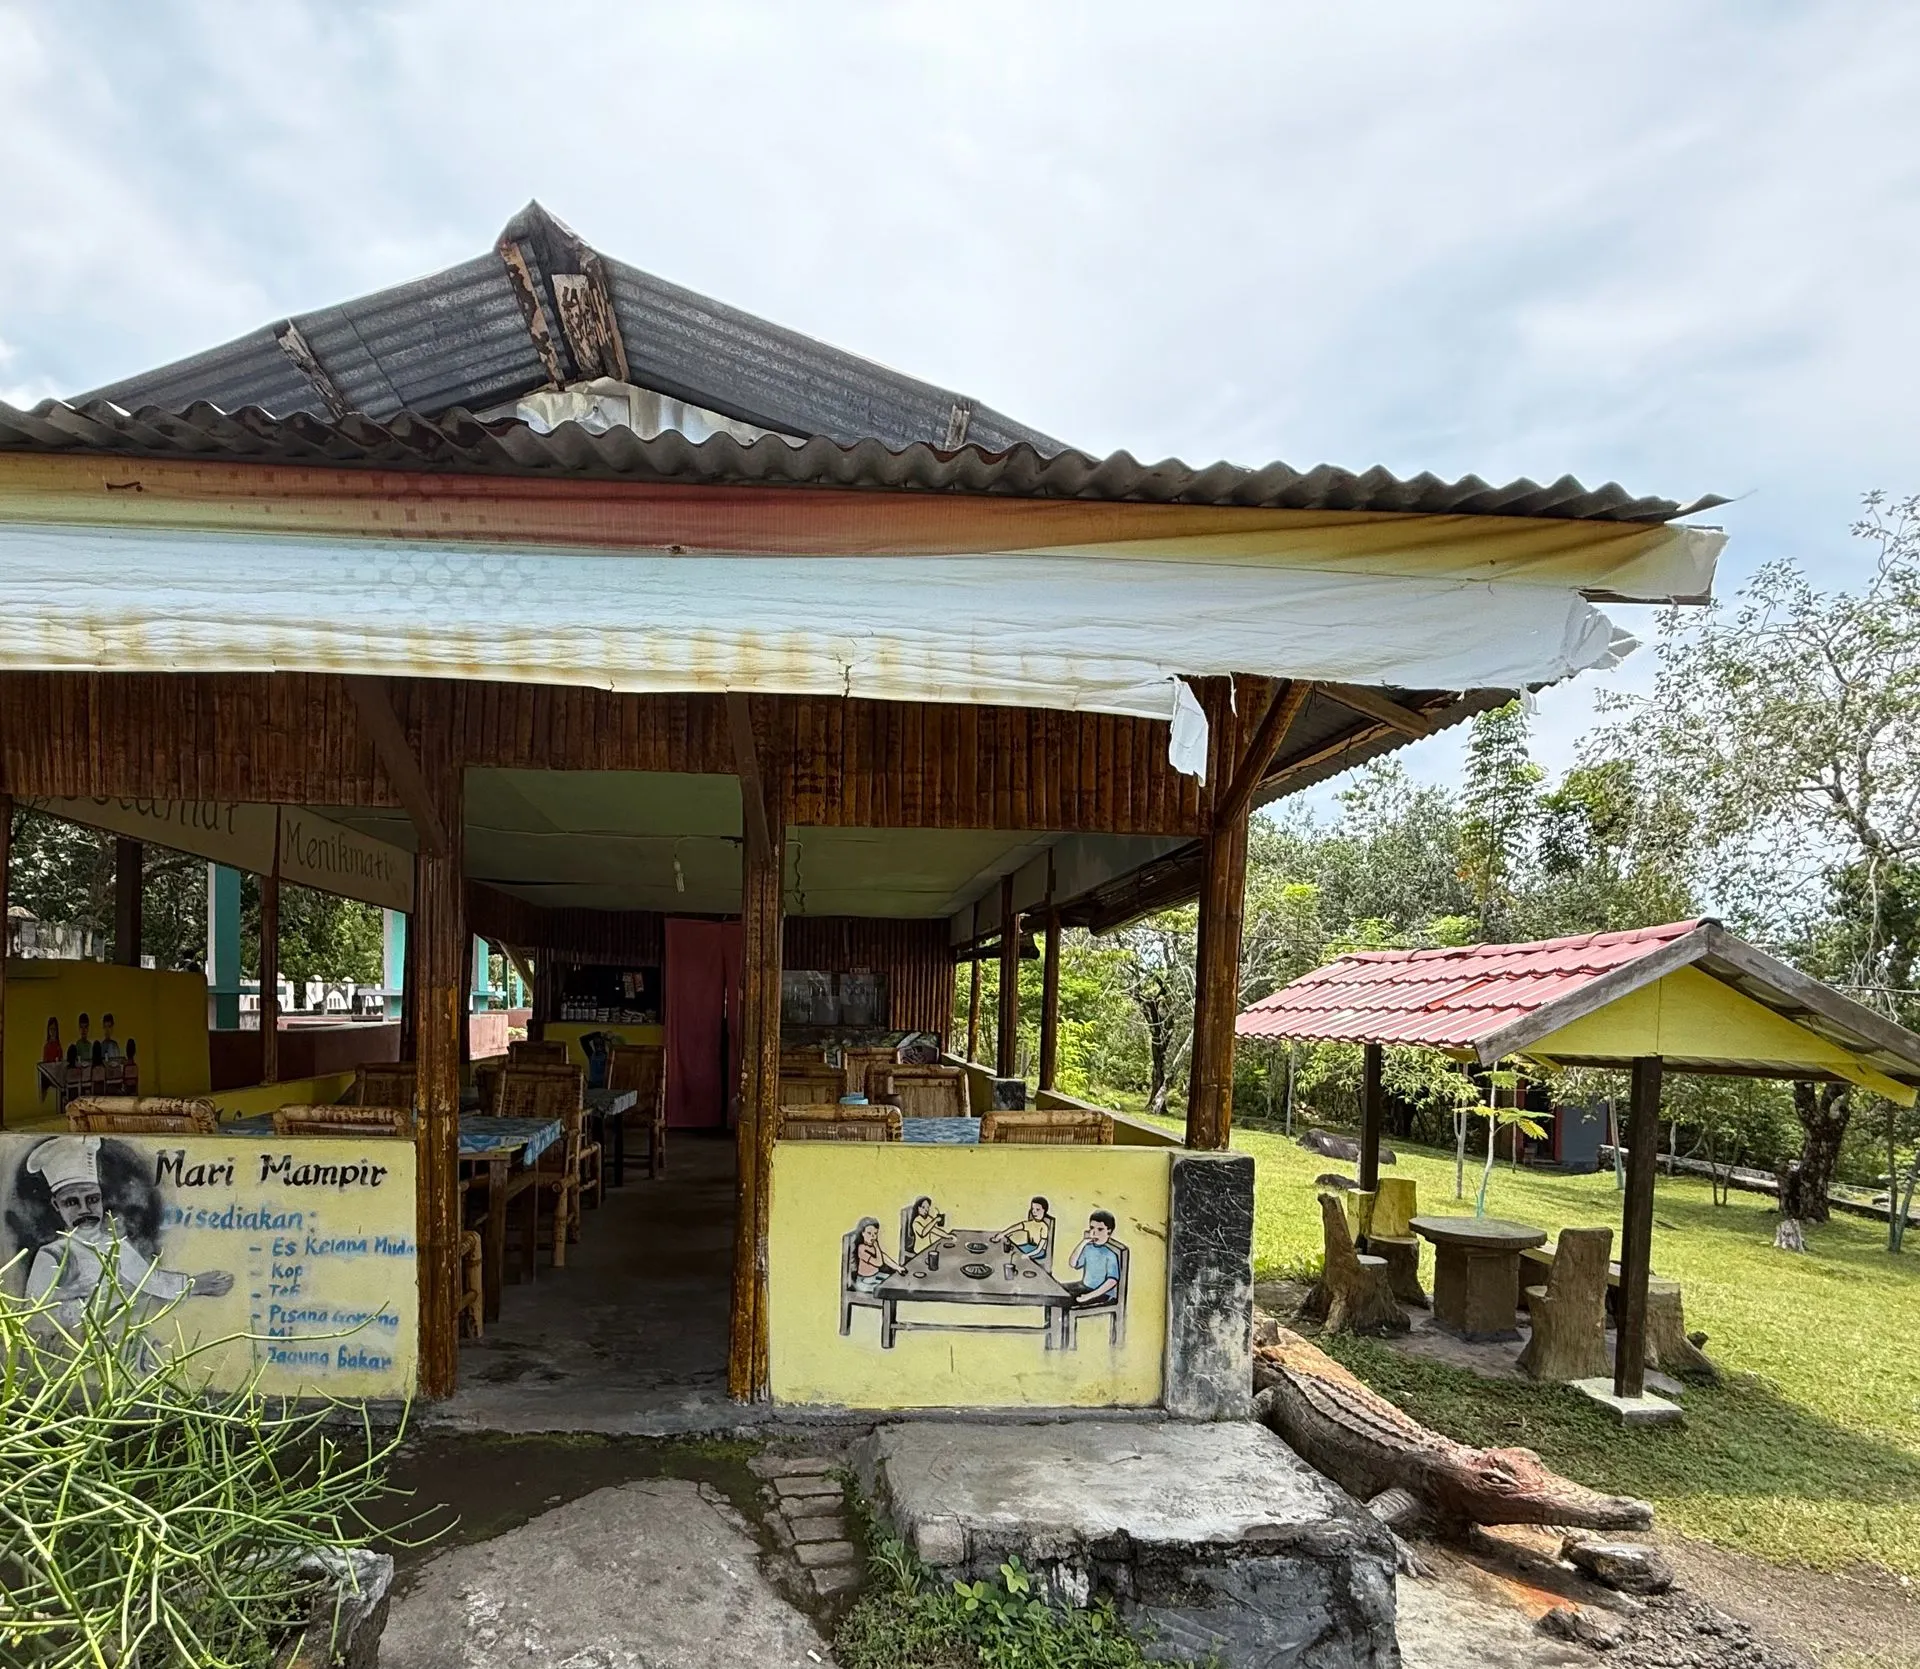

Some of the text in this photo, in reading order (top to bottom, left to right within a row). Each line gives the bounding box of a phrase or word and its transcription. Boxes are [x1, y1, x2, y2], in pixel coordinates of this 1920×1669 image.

[283, 818, 391, 882] Menikmati
[154, 1148, 388, 1194] Mari Mampir
[272, 1237, 297, 1257] Es
